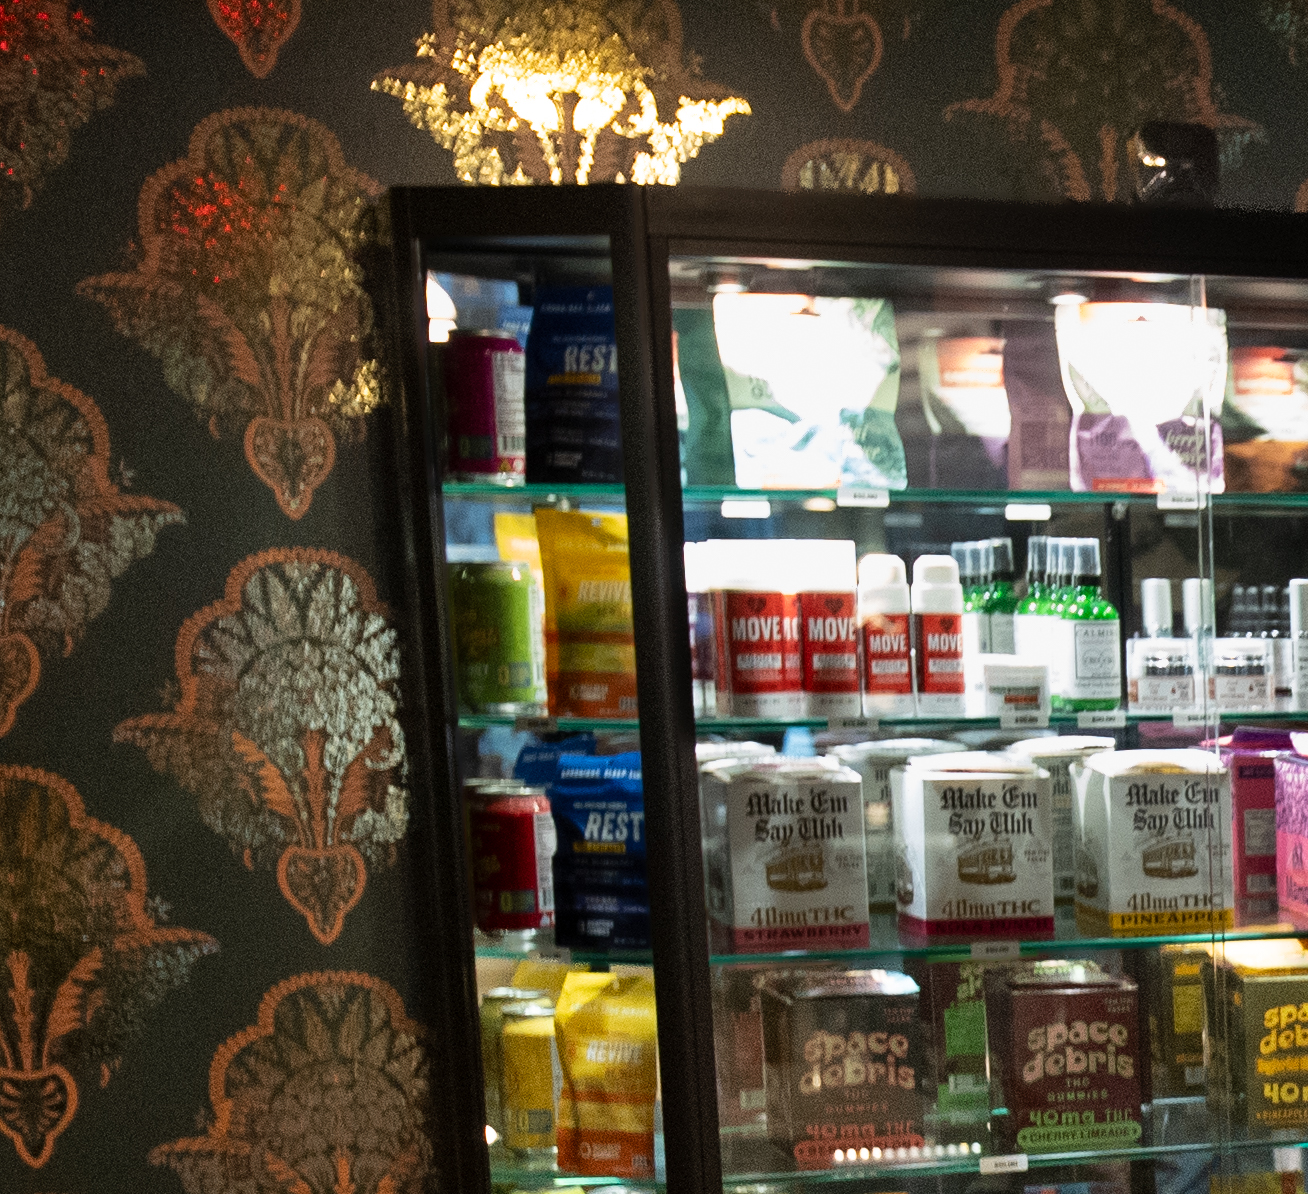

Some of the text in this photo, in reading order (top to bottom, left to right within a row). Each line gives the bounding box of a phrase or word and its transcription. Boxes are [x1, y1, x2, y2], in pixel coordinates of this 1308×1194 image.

[732, 616, 781, 641] MOVE
[808, 616, 856, 641] MOVE
[870, 633, 907, 652] MOVE
[927, 633, 963, 652] MOVE
[745, 791, 803, 817] Make
[939, 786, 996, 811] Make
[1125, 783, 1180, 807] Make
[583, 811, 645, 843] REST
[754, 816, 845, 845] Say Uhh
[948, 811, 1035, 837] Say Uhh
[1131, 807, 1215, 836] Say Uhh
[996, 899, 1041, 916] THC
[1182, 892, 1222, 908] THC
[811, 904, 855, 922] THC
[1120, 909, 1228, 926] PINEAPPLE
[743, 924, 863, 942] STRAWBERRY
[803, 1031, 910, 1064] space
[1027, 1020, 1129, 1053] space
[585, 1039, 643, 1066] REVIVE
[1022, 1042, 1135, 1085] debris
[799, 1053, 917, 1097] debris
[1046, 1089, 1109, 1103] GUMMIES
[1030, 1130, 1077, 1143] CHERRY
